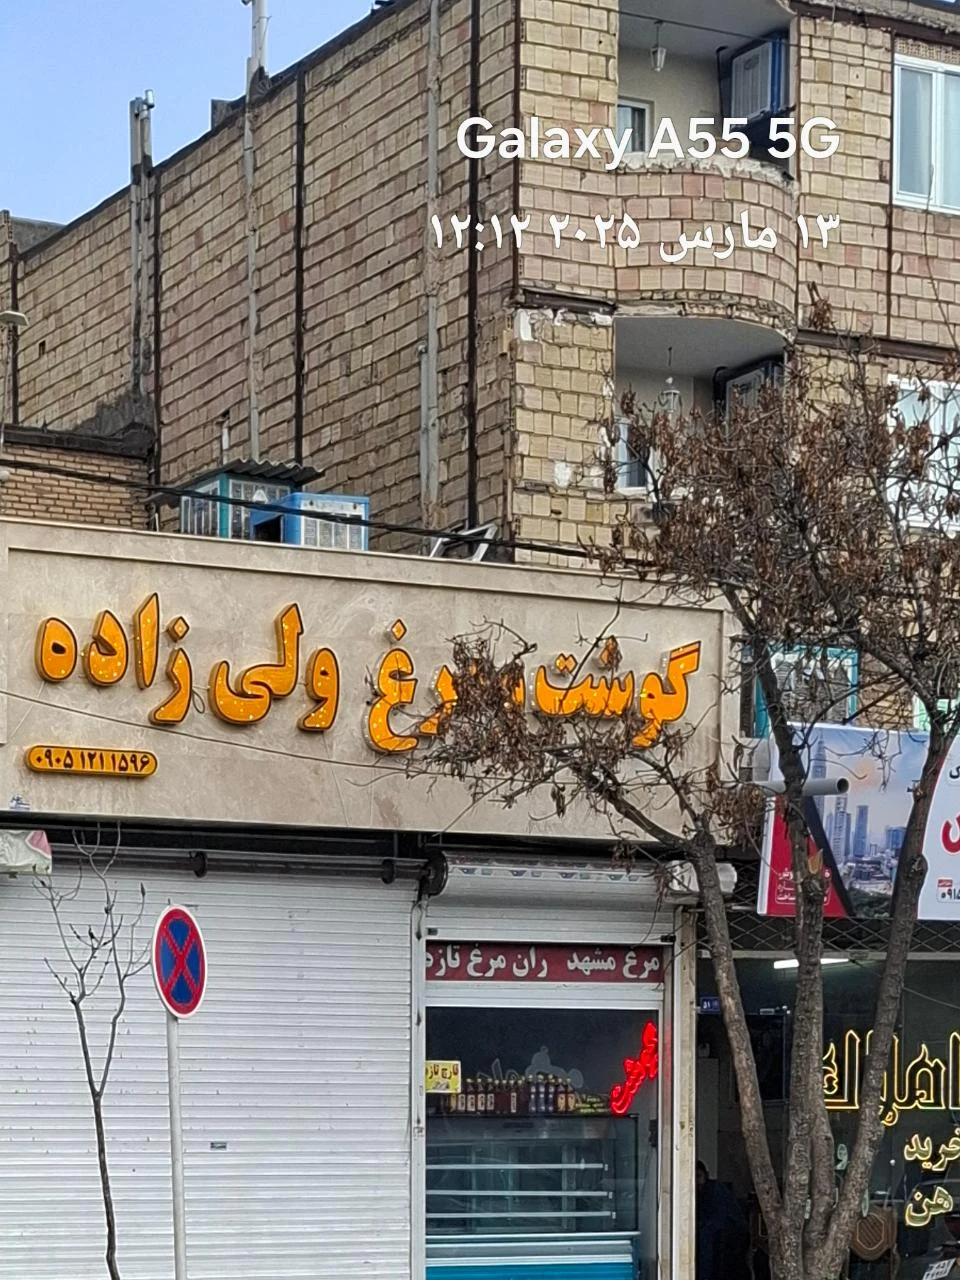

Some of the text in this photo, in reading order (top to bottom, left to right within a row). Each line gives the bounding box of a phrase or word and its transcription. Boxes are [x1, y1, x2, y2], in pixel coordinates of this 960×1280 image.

[34, 592, 193, 725] زاده
[209, 602, 340, 732] ولی
[365, 617, 492, 754] رغ
[531, 635, 702, 749] گوشت
[466, 943, 506, 977] مرغ
[512, 946, 548, 978] ران
[567, 948, 616, 976] مشهد
[622, 946, 659, 978] مرغ
